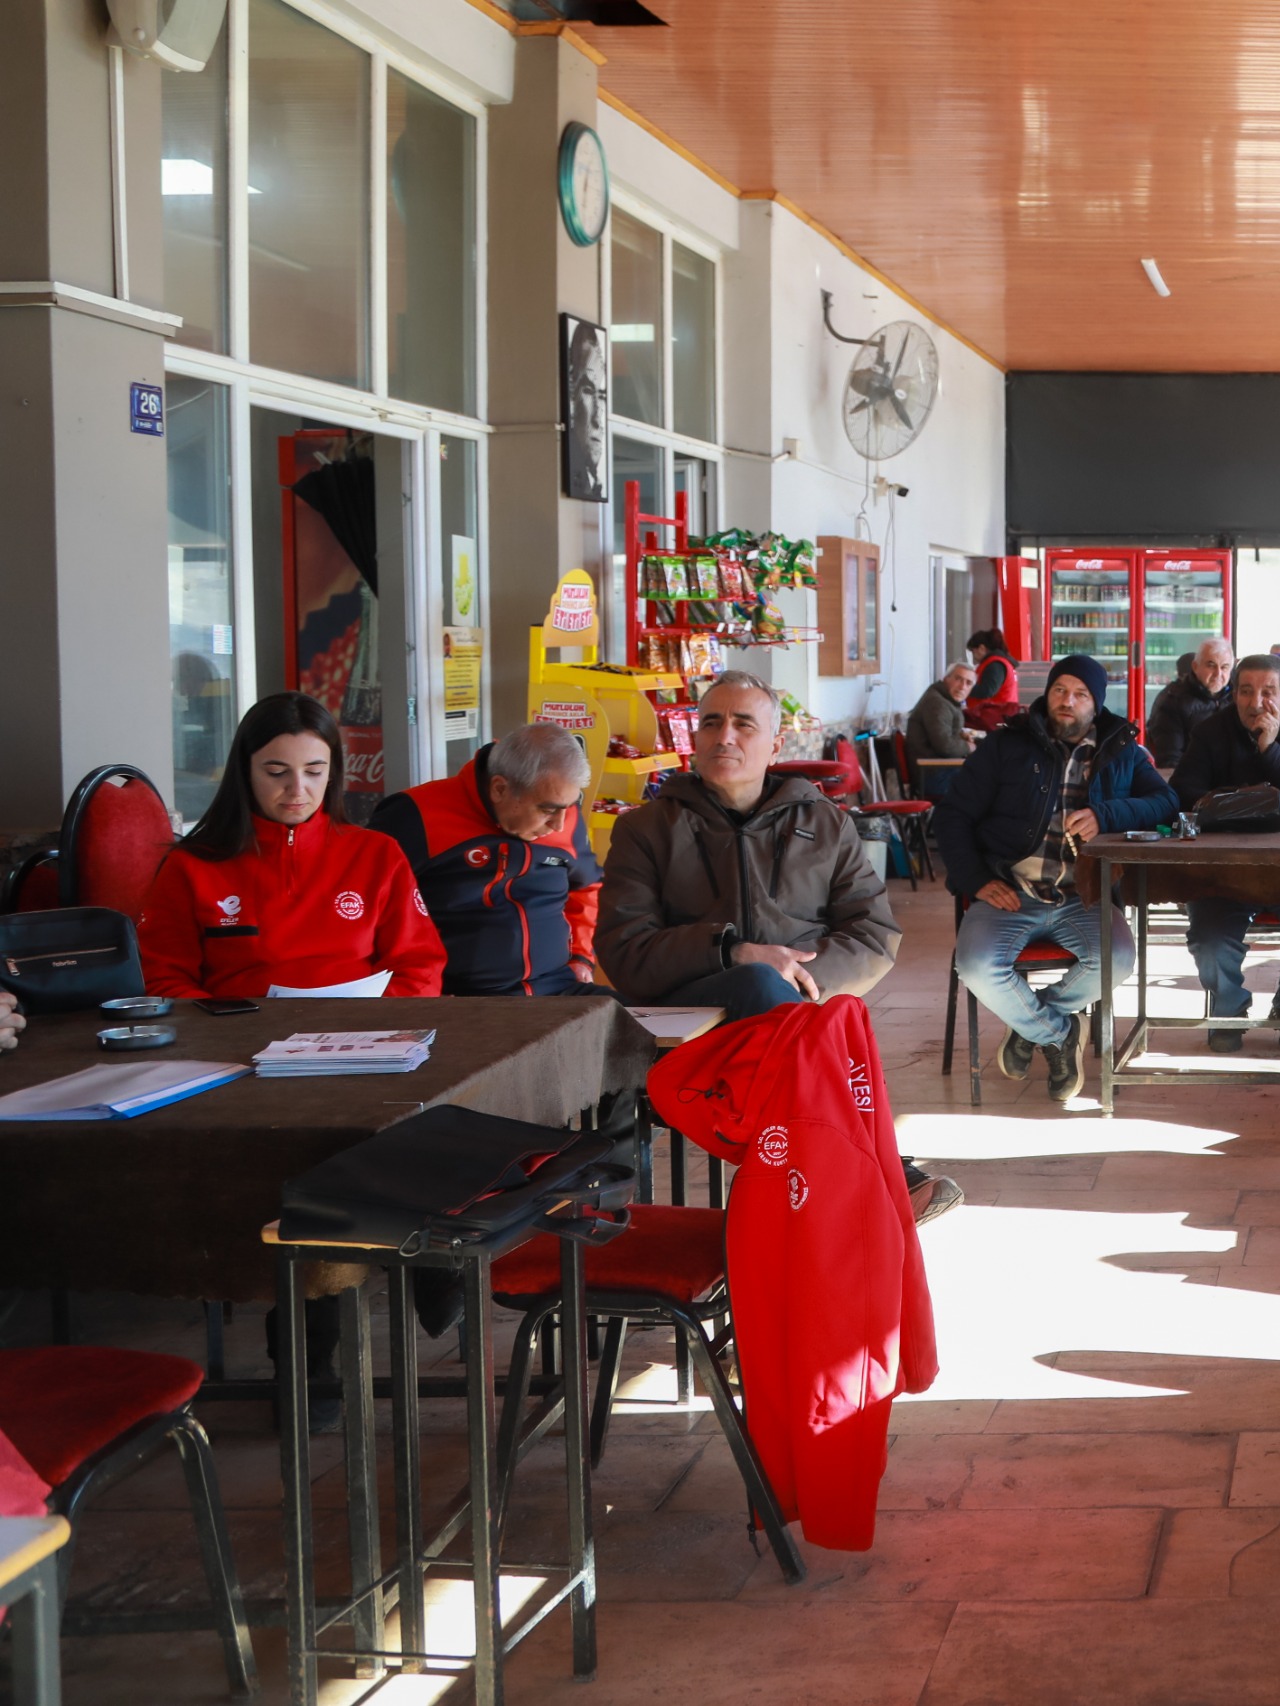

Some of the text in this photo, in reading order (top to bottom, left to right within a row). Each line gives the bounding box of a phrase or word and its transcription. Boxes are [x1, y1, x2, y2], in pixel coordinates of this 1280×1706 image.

[140, 392, 157, 415] 26
[340, 901, 360, 909] EFAK
[763, 1141, 789, 1151] EFAK
